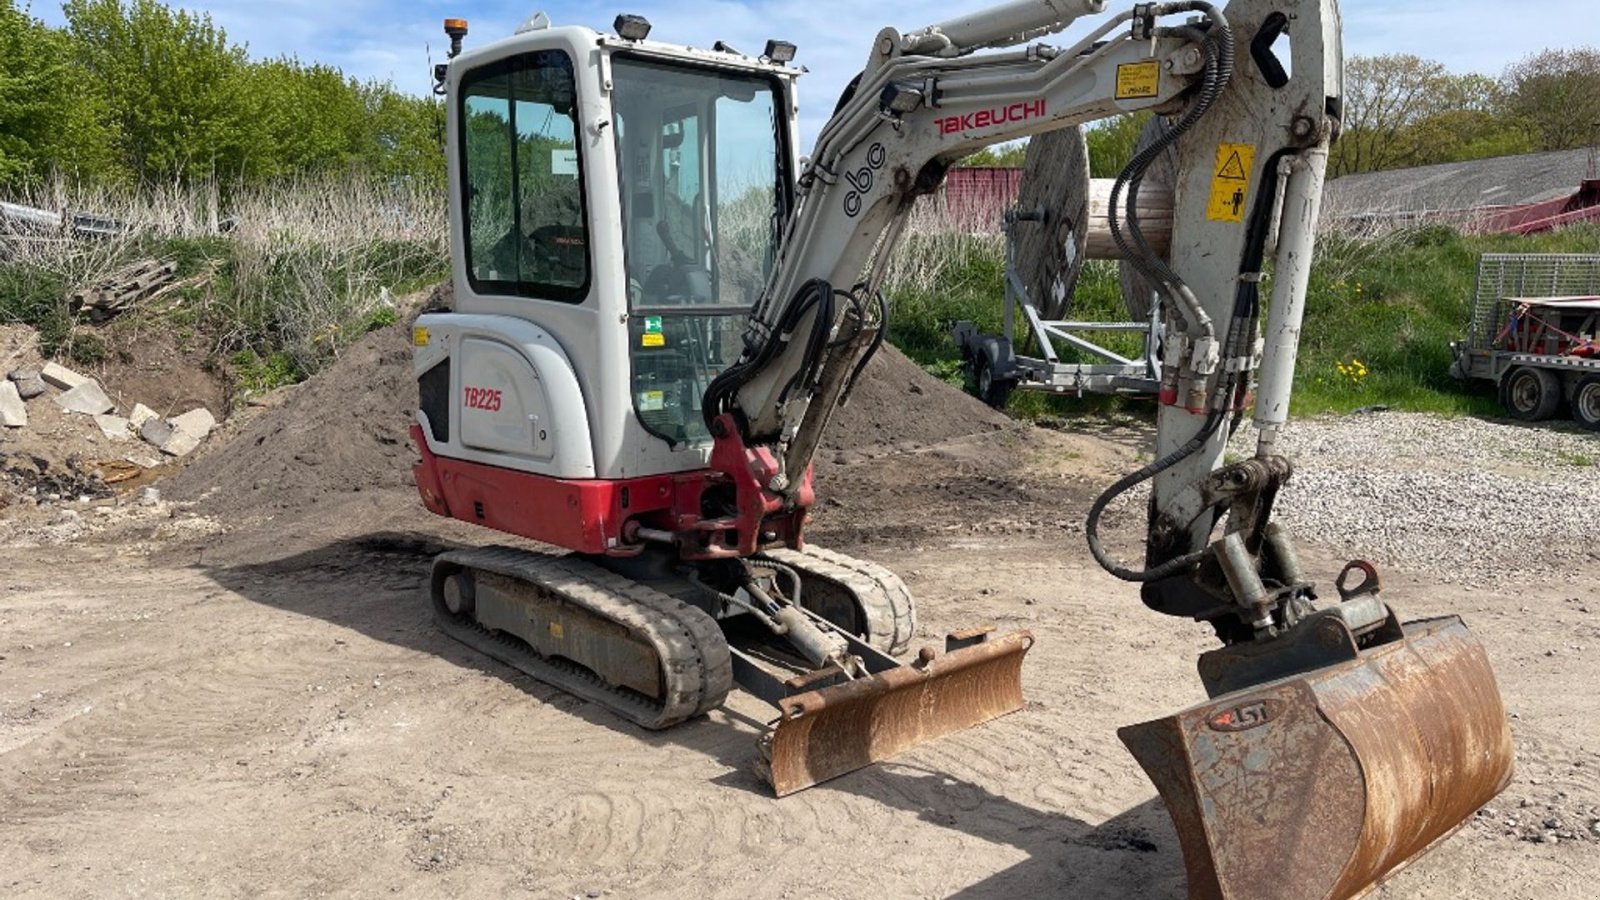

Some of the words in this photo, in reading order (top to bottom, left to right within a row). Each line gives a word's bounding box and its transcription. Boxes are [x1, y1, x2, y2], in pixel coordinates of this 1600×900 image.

[934, 98, 1046, 136] TAKEUCHI
[843, 142, 886, 218] cbc
[464, 387, 502, 412] TB225
